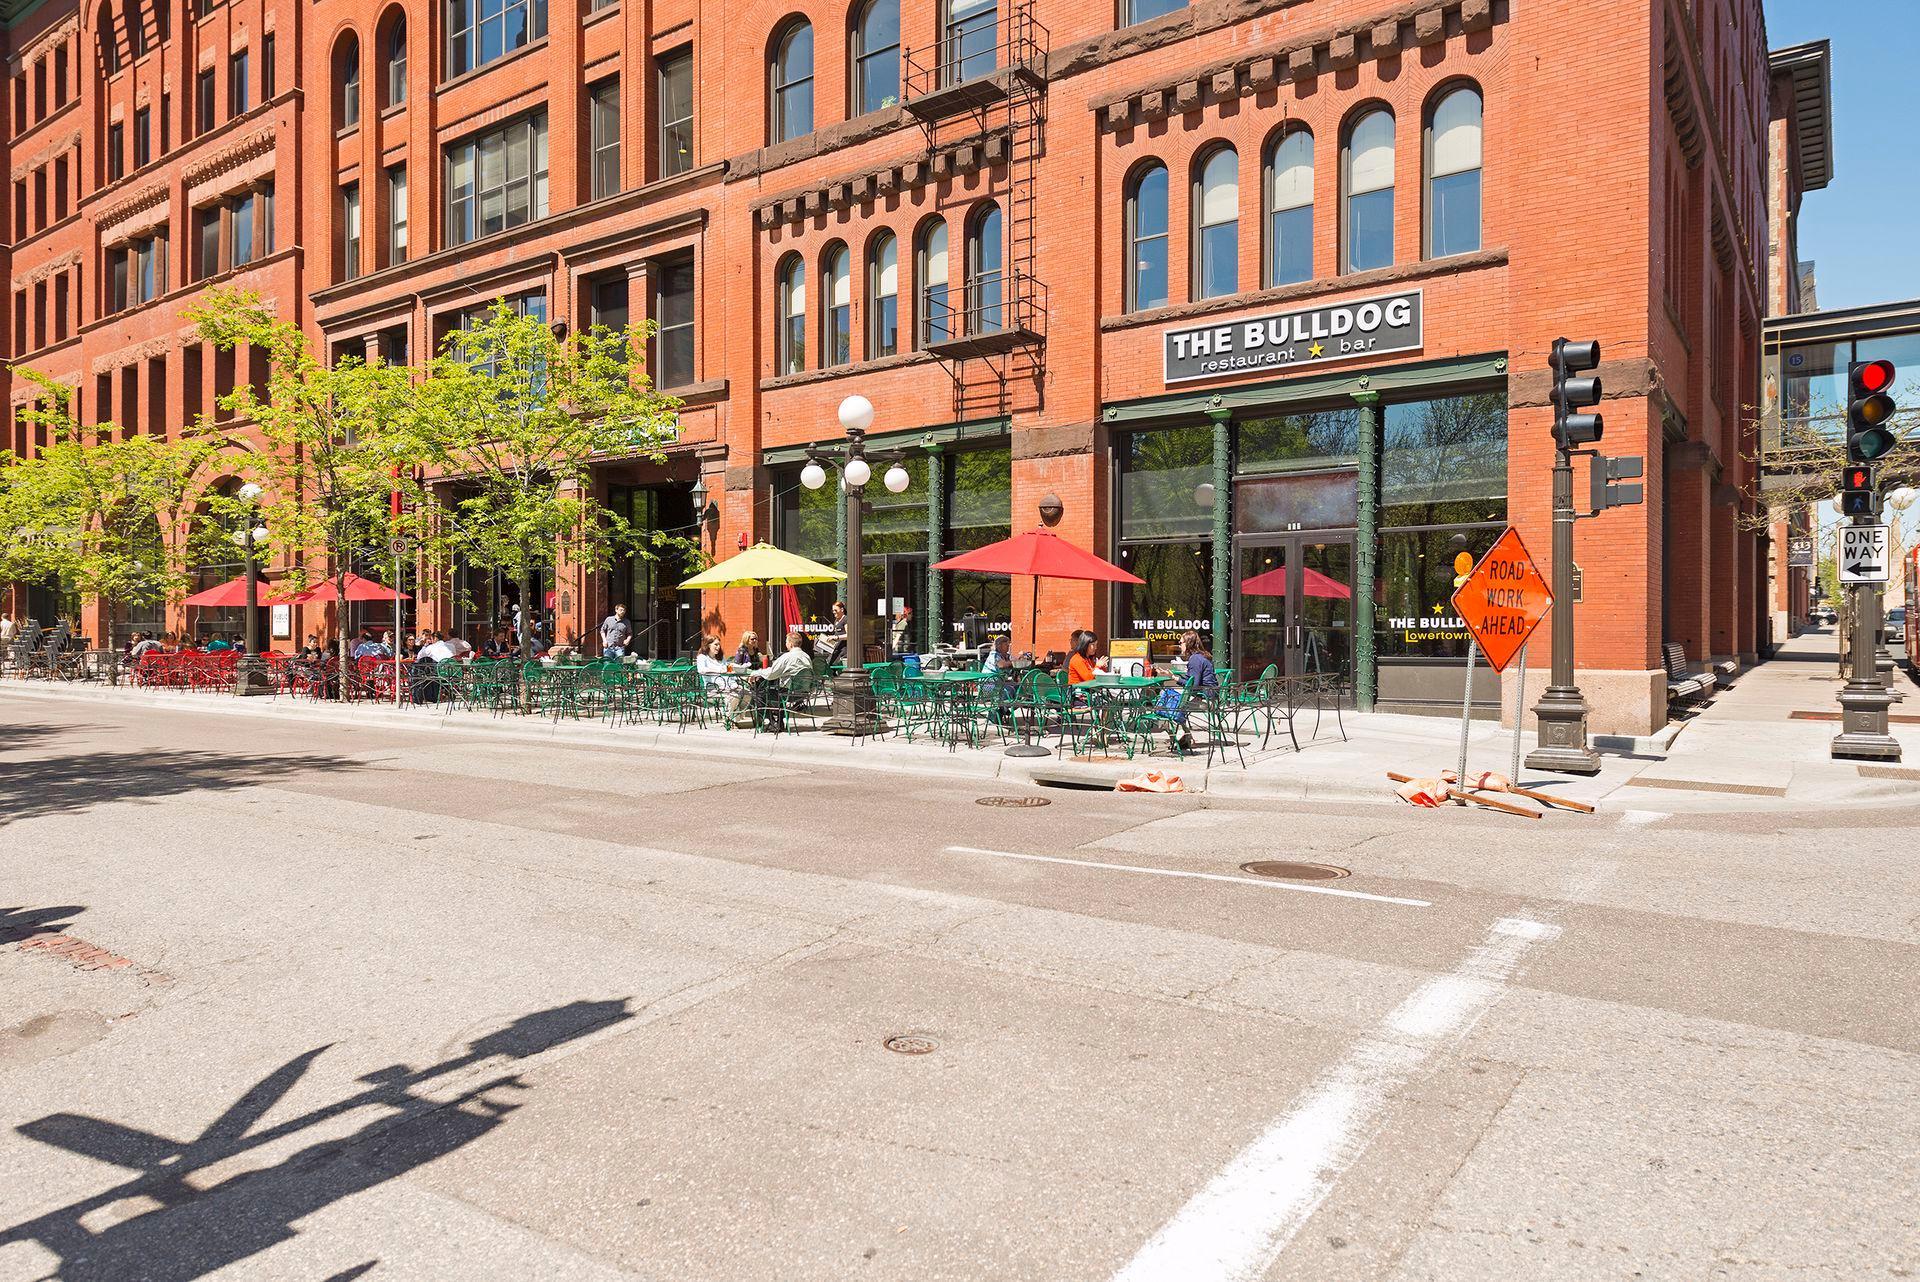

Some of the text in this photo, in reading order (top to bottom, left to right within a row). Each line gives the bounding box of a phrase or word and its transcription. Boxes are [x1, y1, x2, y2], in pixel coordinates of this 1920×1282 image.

[1173, 298, 1412, 360] THE BULLDOG
[1200, 335, 1376, 373] restaurant bar
[1791, 356, 1802, 365] 15
[1845, 530, 1883, 544] ONE
[1791, 541, 1811, 551] 413
[1844, 546, 1884, 560] WAY
[1490, 560, 1525, 580] ROAD
[1487, 588, 1524, 608] WORK
[788, 624, 835, 633] THE BULLDO
[952, 622, 965, 632] TH
[1132, 619, 1210, 630] THE BULLDOG
[1388, 617, 1466, 629] THE BULLD
[1480, 615, 1525, 635] AHEAD
[1405, 629, 1472, 643] Lowertown
